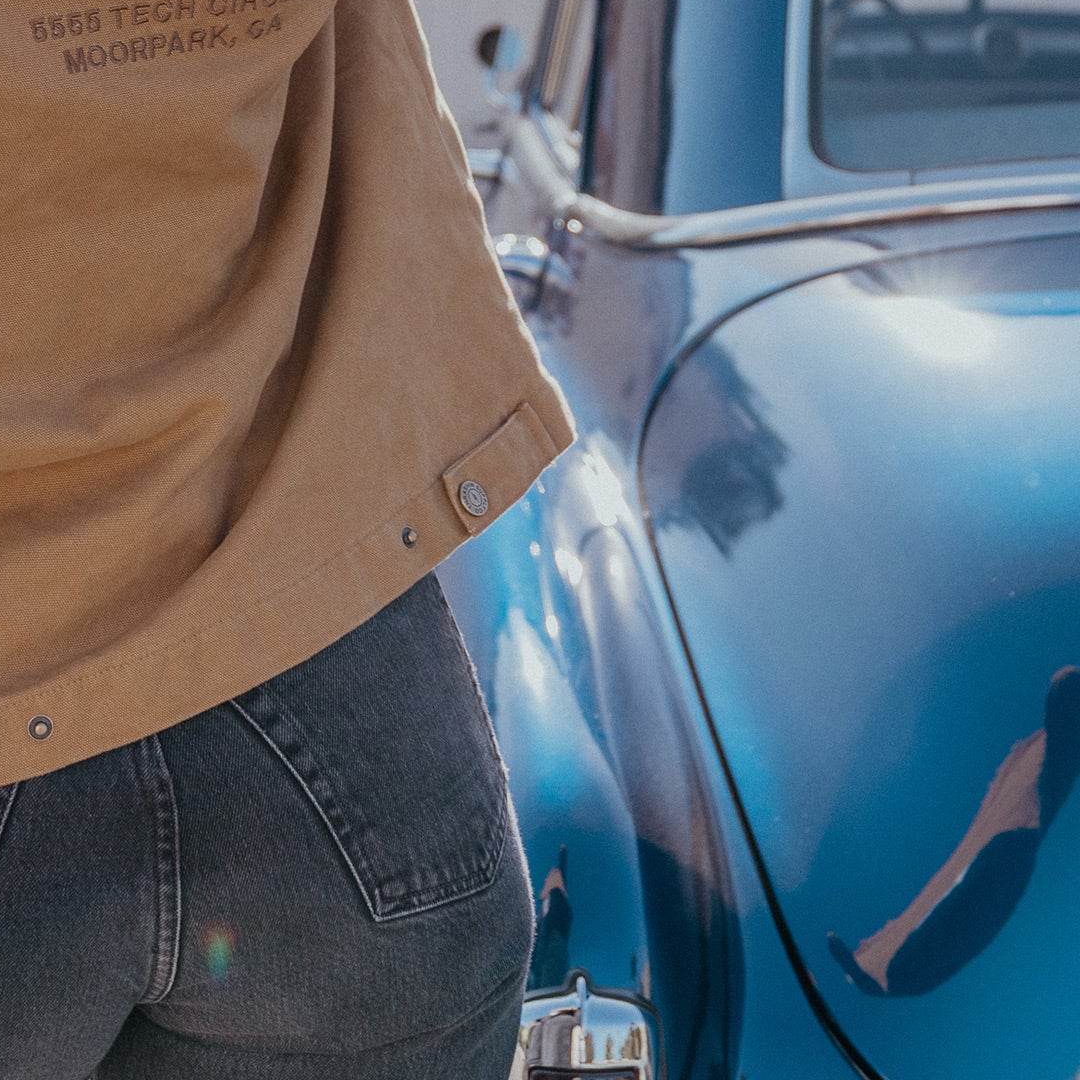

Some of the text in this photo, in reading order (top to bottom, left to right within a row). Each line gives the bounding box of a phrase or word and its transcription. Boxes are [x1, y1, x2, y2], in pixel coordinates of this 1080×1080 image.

[30, 9, 102, 43] 5555
[62, 12, 283, 75] MOORPARK, CA
